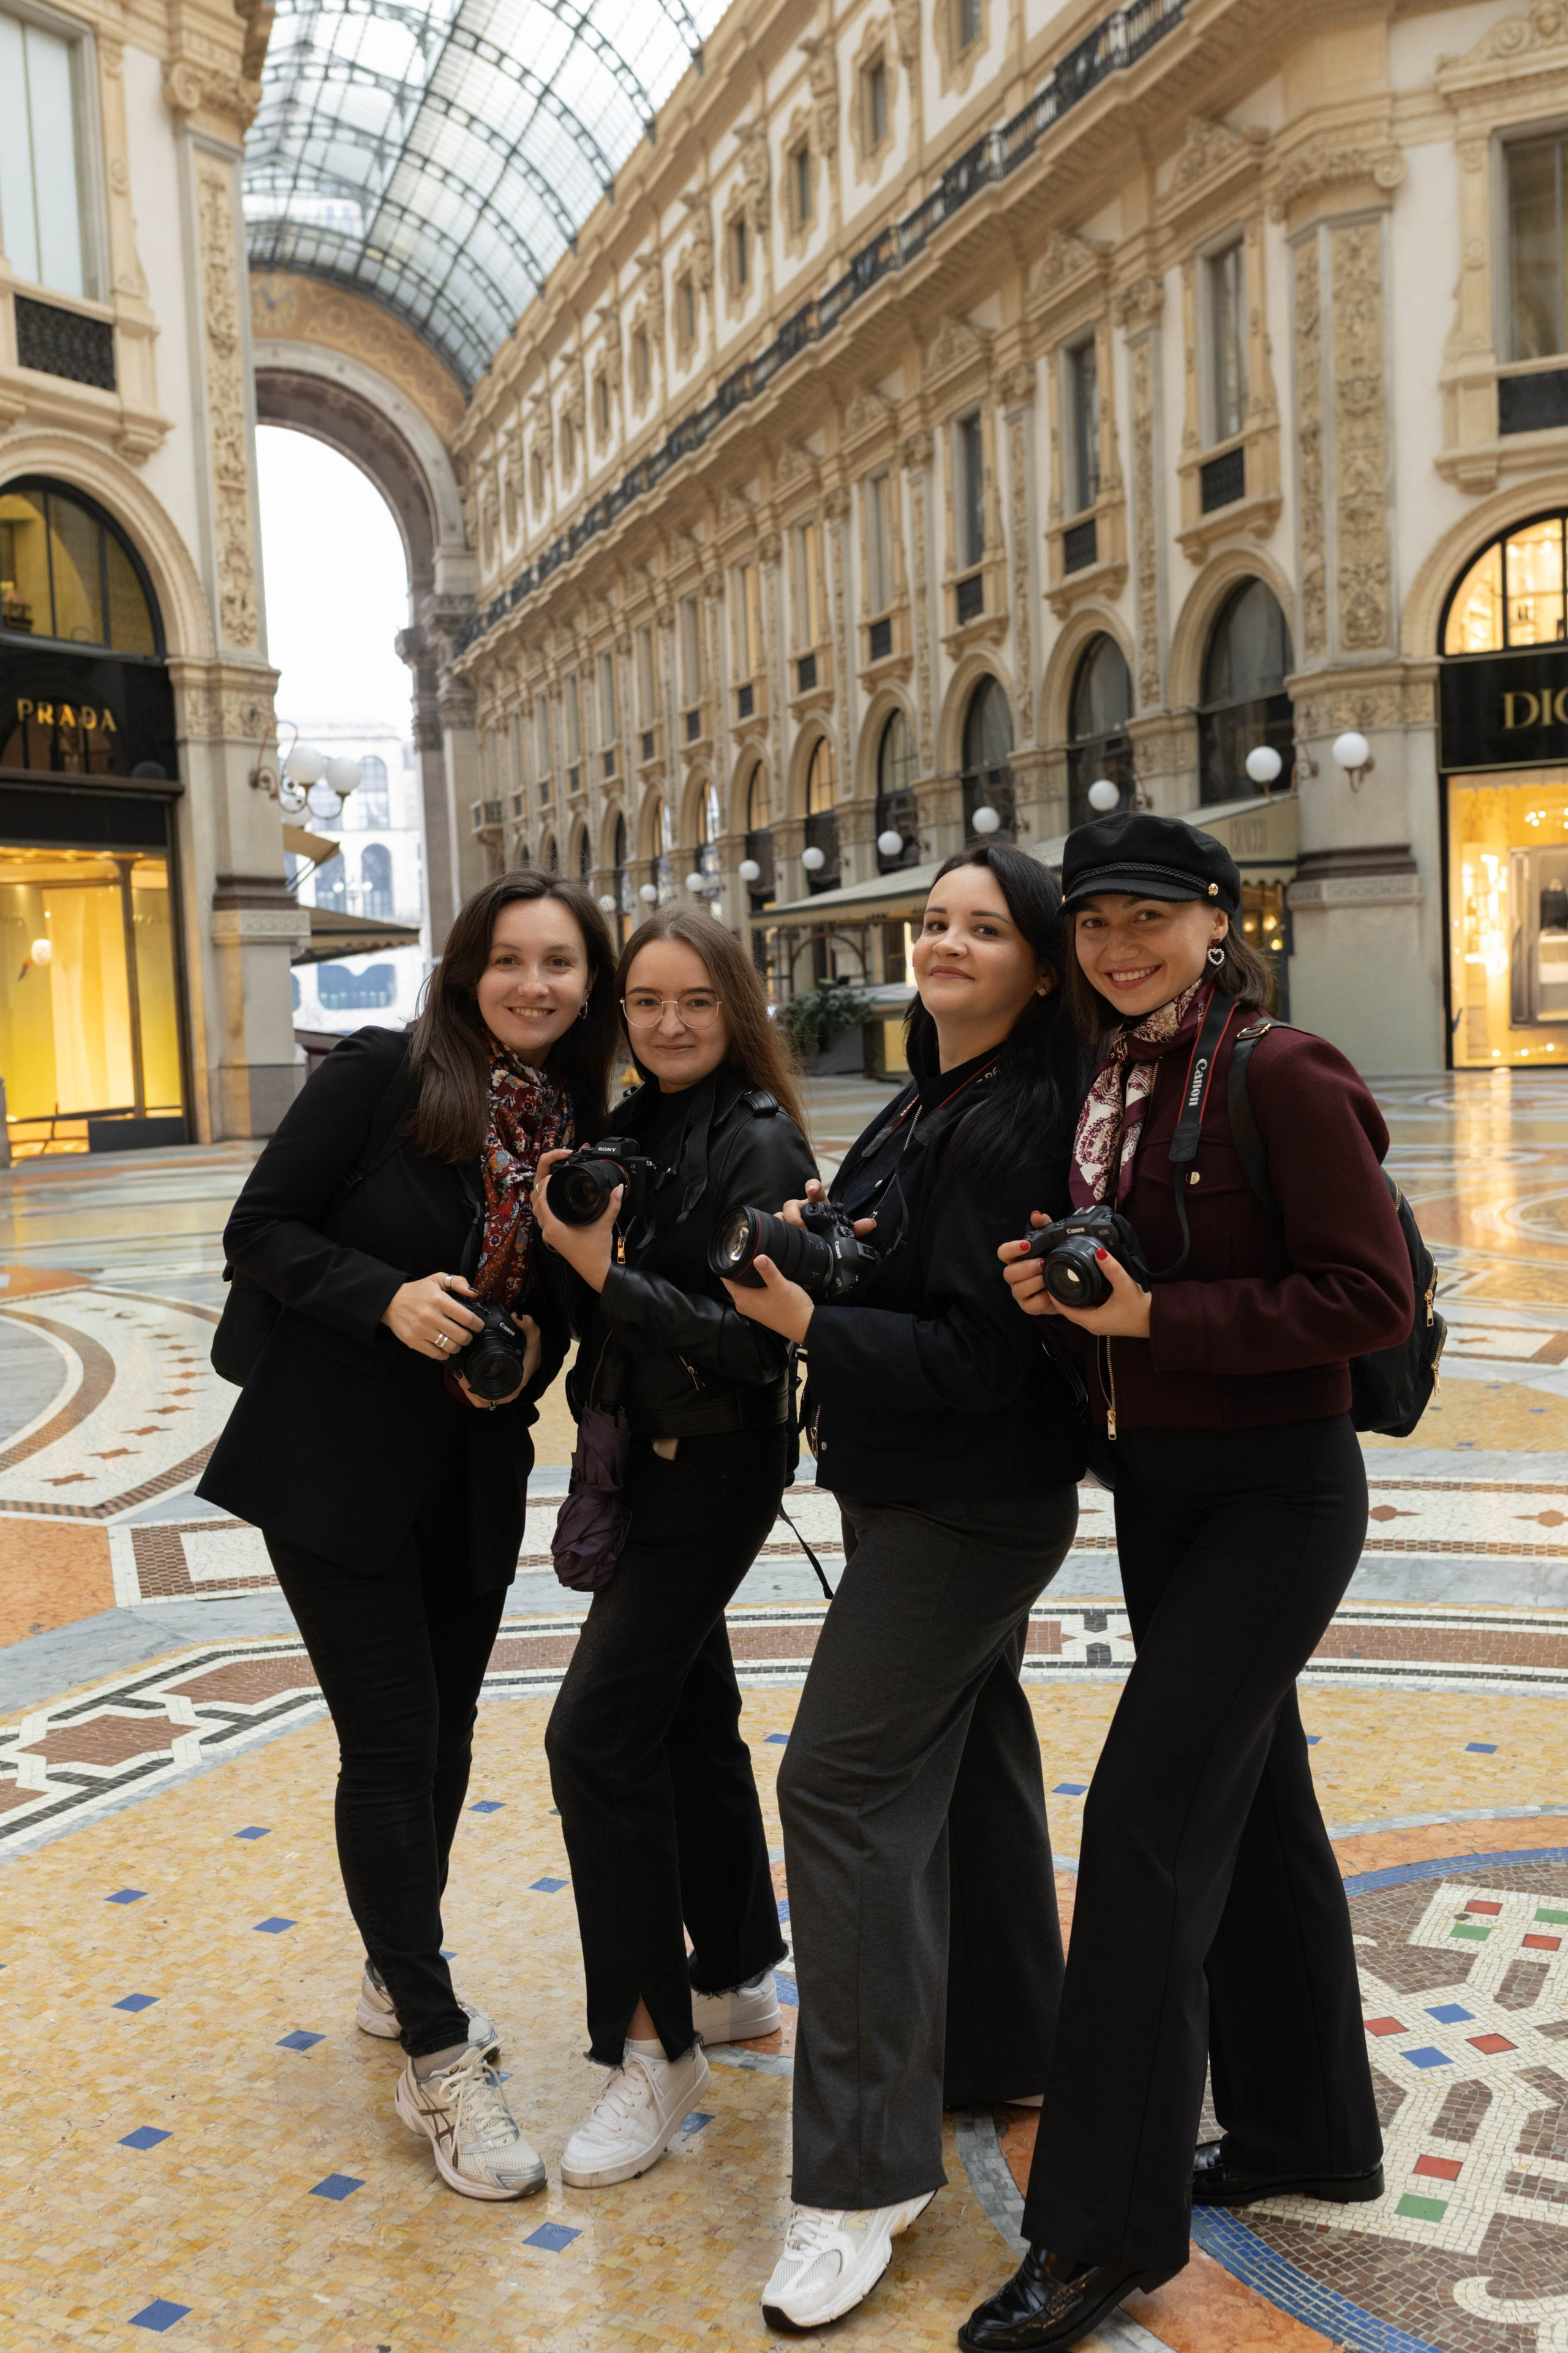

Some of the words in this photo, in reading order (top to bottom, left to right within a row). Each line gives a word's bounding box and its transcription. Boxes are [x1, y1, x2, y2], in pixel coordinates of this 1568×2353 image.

[17, 698, 118, 732] PRADA
[1188, 1059, 1207, 1106] Canon
[500, 1322, 515, 1336] Canon
